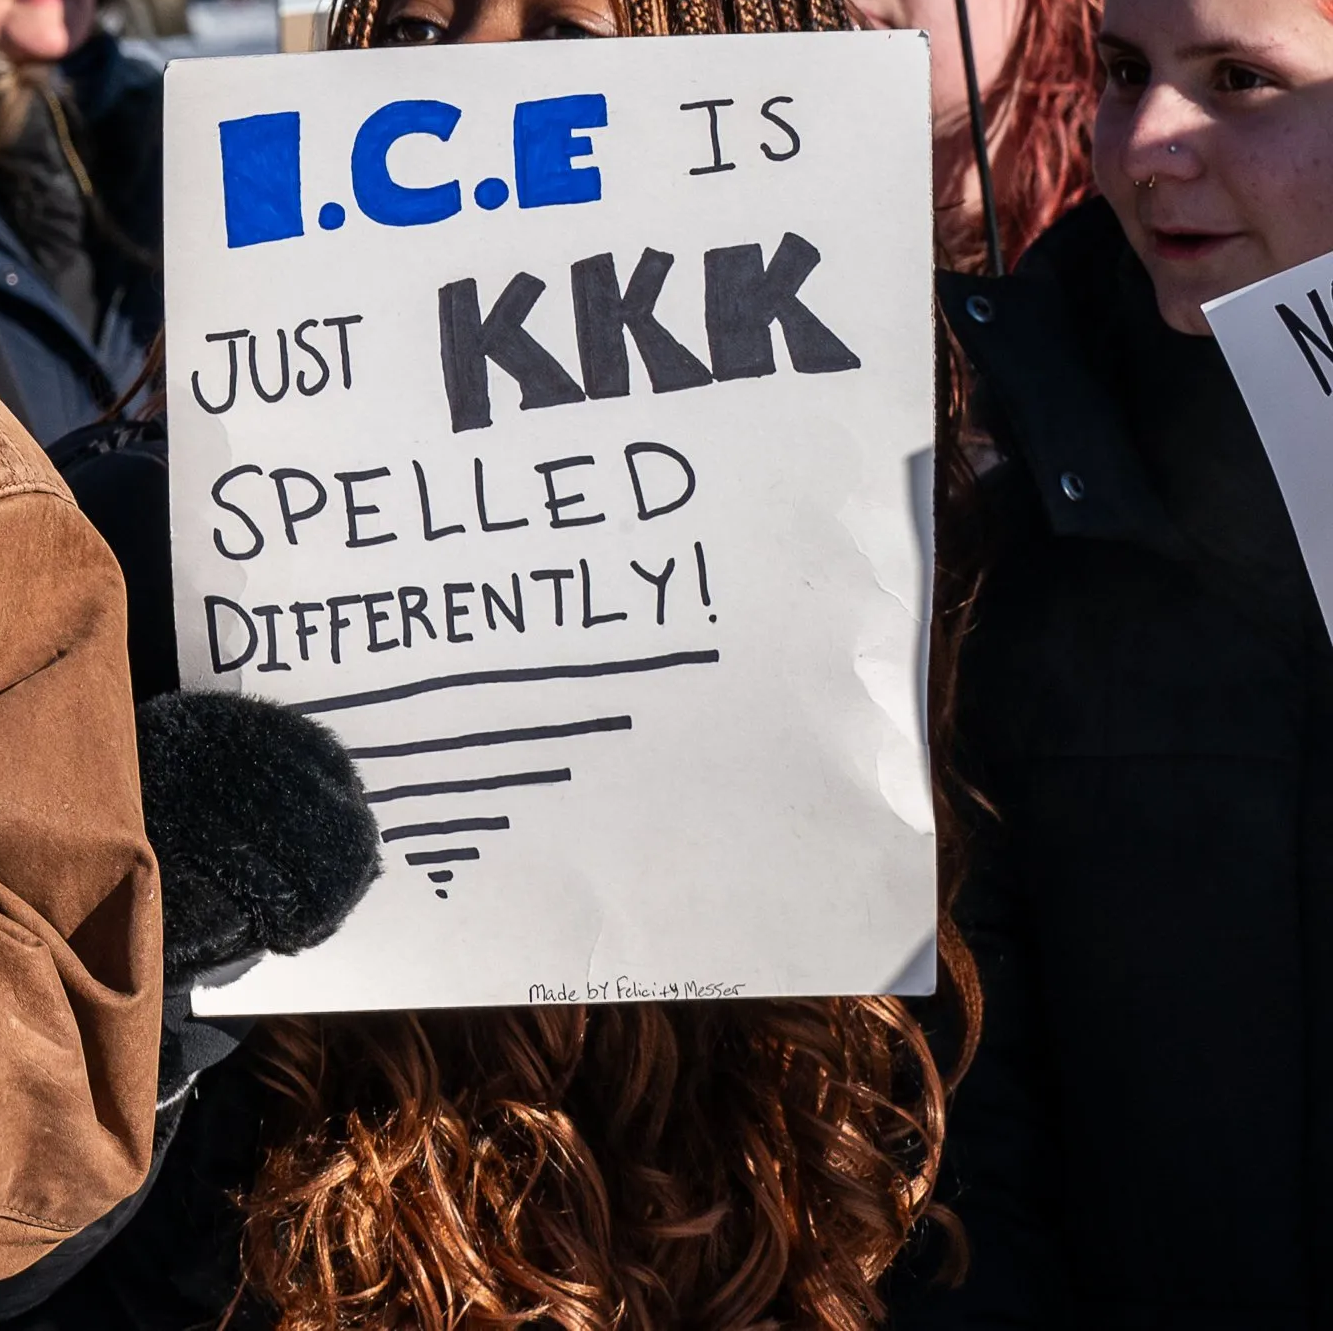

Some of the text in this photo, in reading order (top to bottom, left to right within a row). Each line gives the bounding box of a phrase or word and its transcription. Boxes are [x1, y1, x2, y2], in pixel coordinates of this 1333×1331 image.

[218, 93, 802, 249] I.C.E IS
[191, 230, 862, 433] JUST KKK
[1274, 280, 1333, 397] N
[210, 440, 697, 561] SPELLED
[203, 540, 720, 675] DIFFERENTLY!
[528, 982, 580, 1003] Made
[616, 975, 679, 1001] Felicity
[684, 980, 746, 1000] Messer
